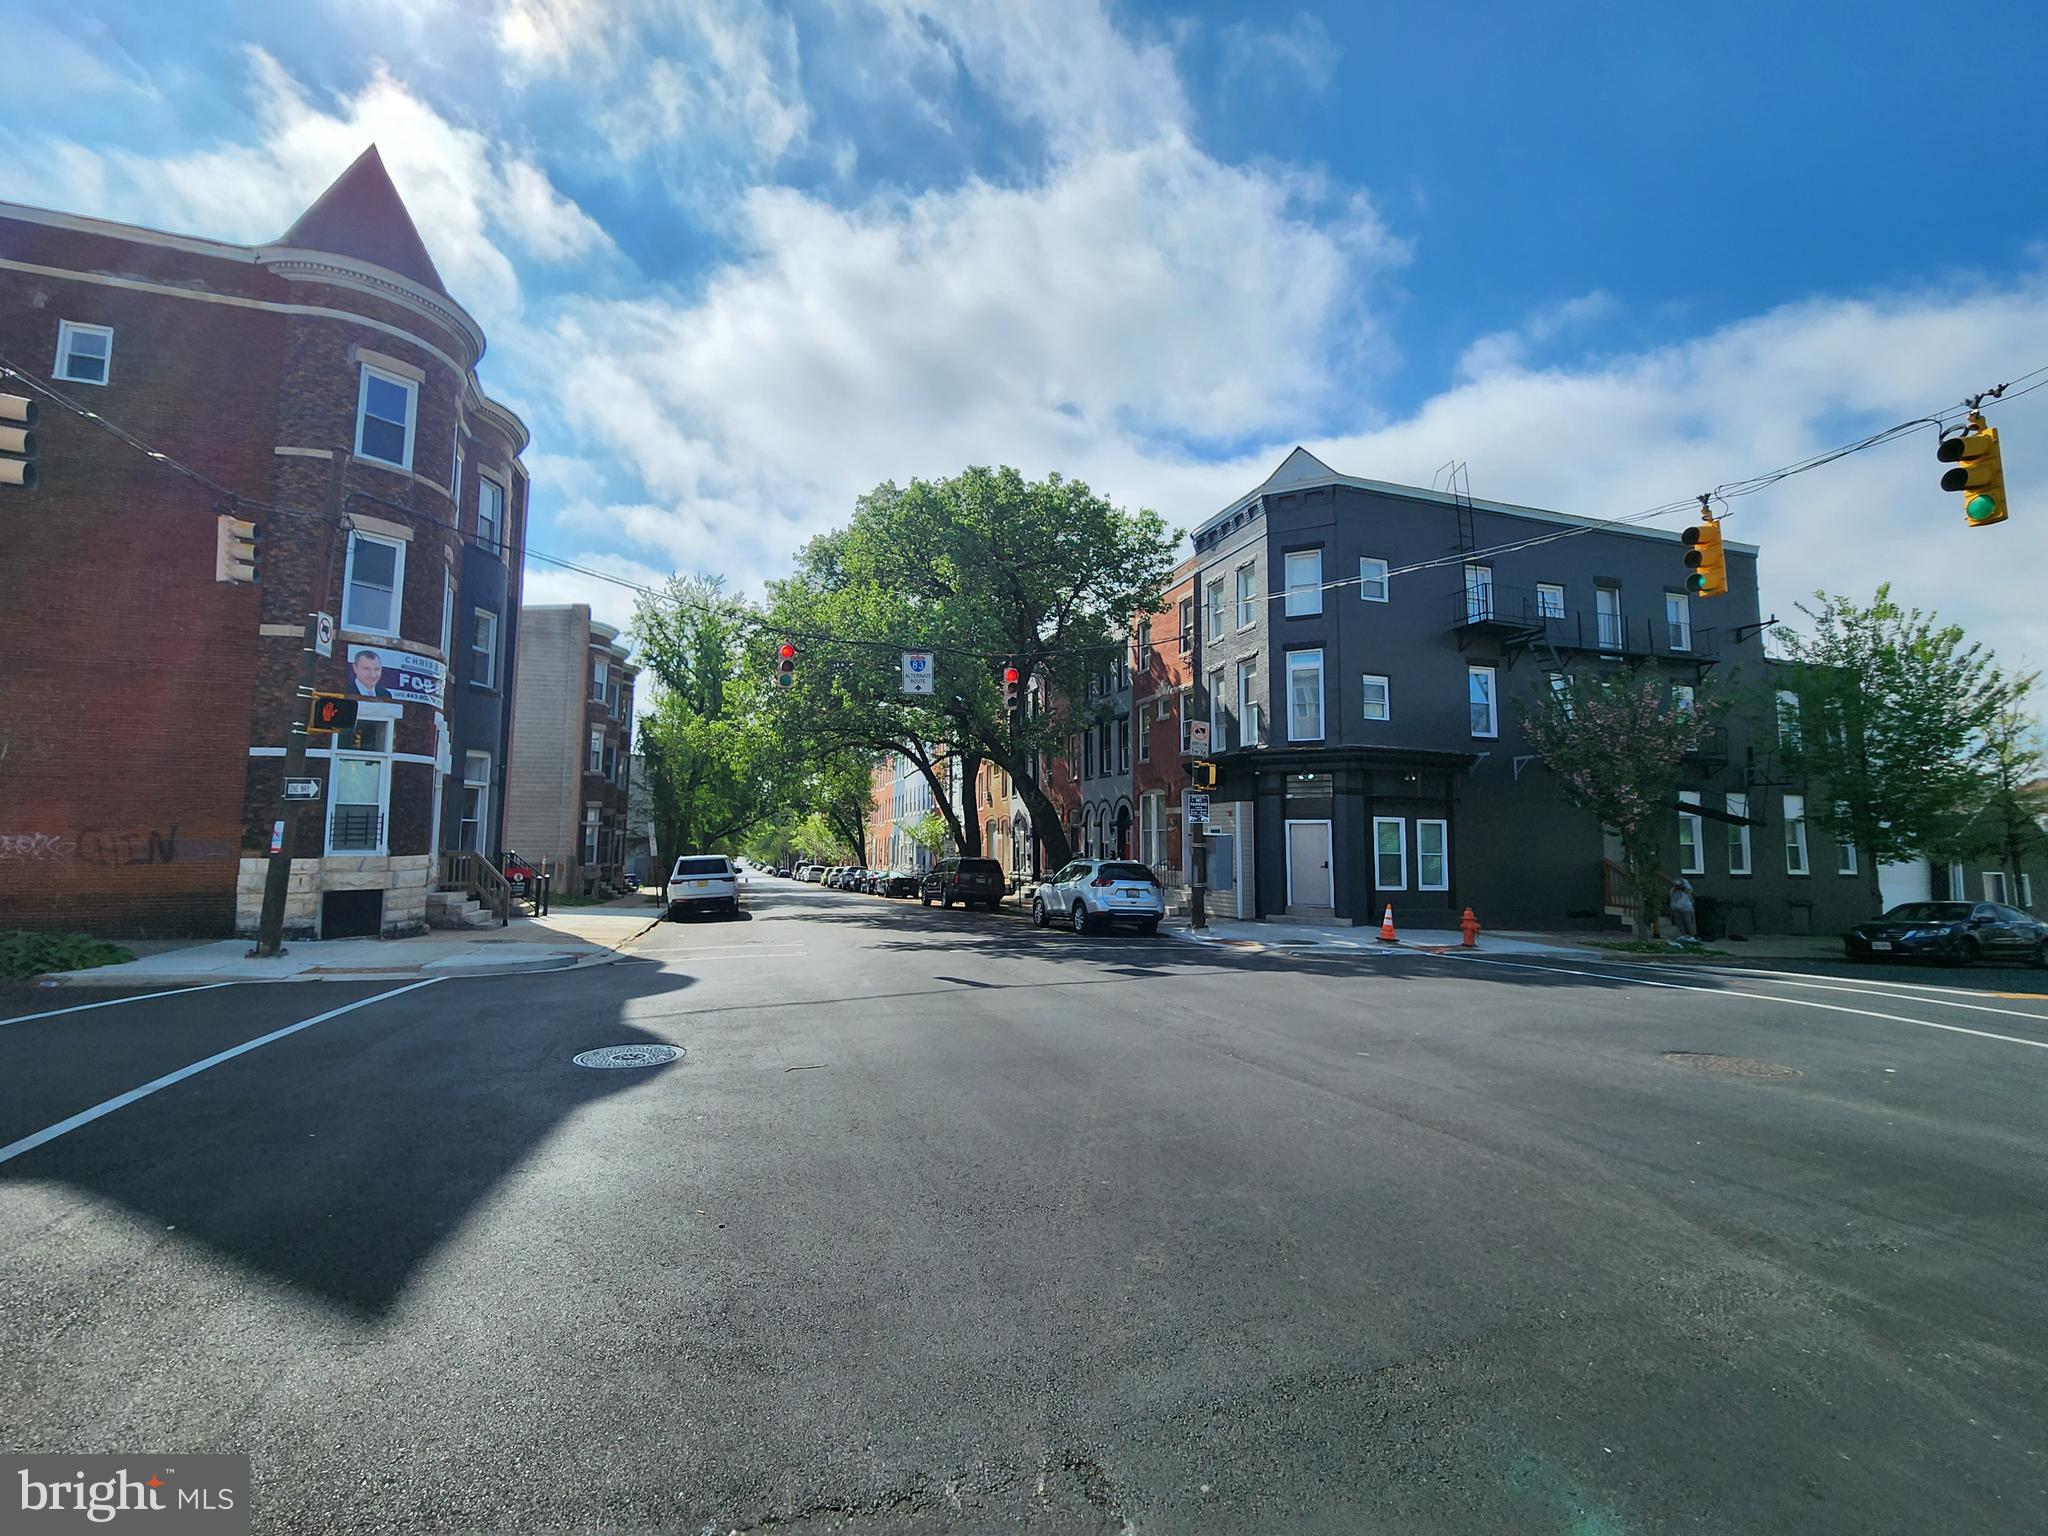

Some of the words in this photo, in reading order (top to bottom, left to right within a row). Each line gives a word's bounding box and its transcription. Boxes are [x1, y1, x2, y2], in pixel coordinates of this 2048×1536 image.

[912, 661, 924, 669] 83
[290, 784, 300, 793] ONE
[300, 784, 310, 793] WAY
